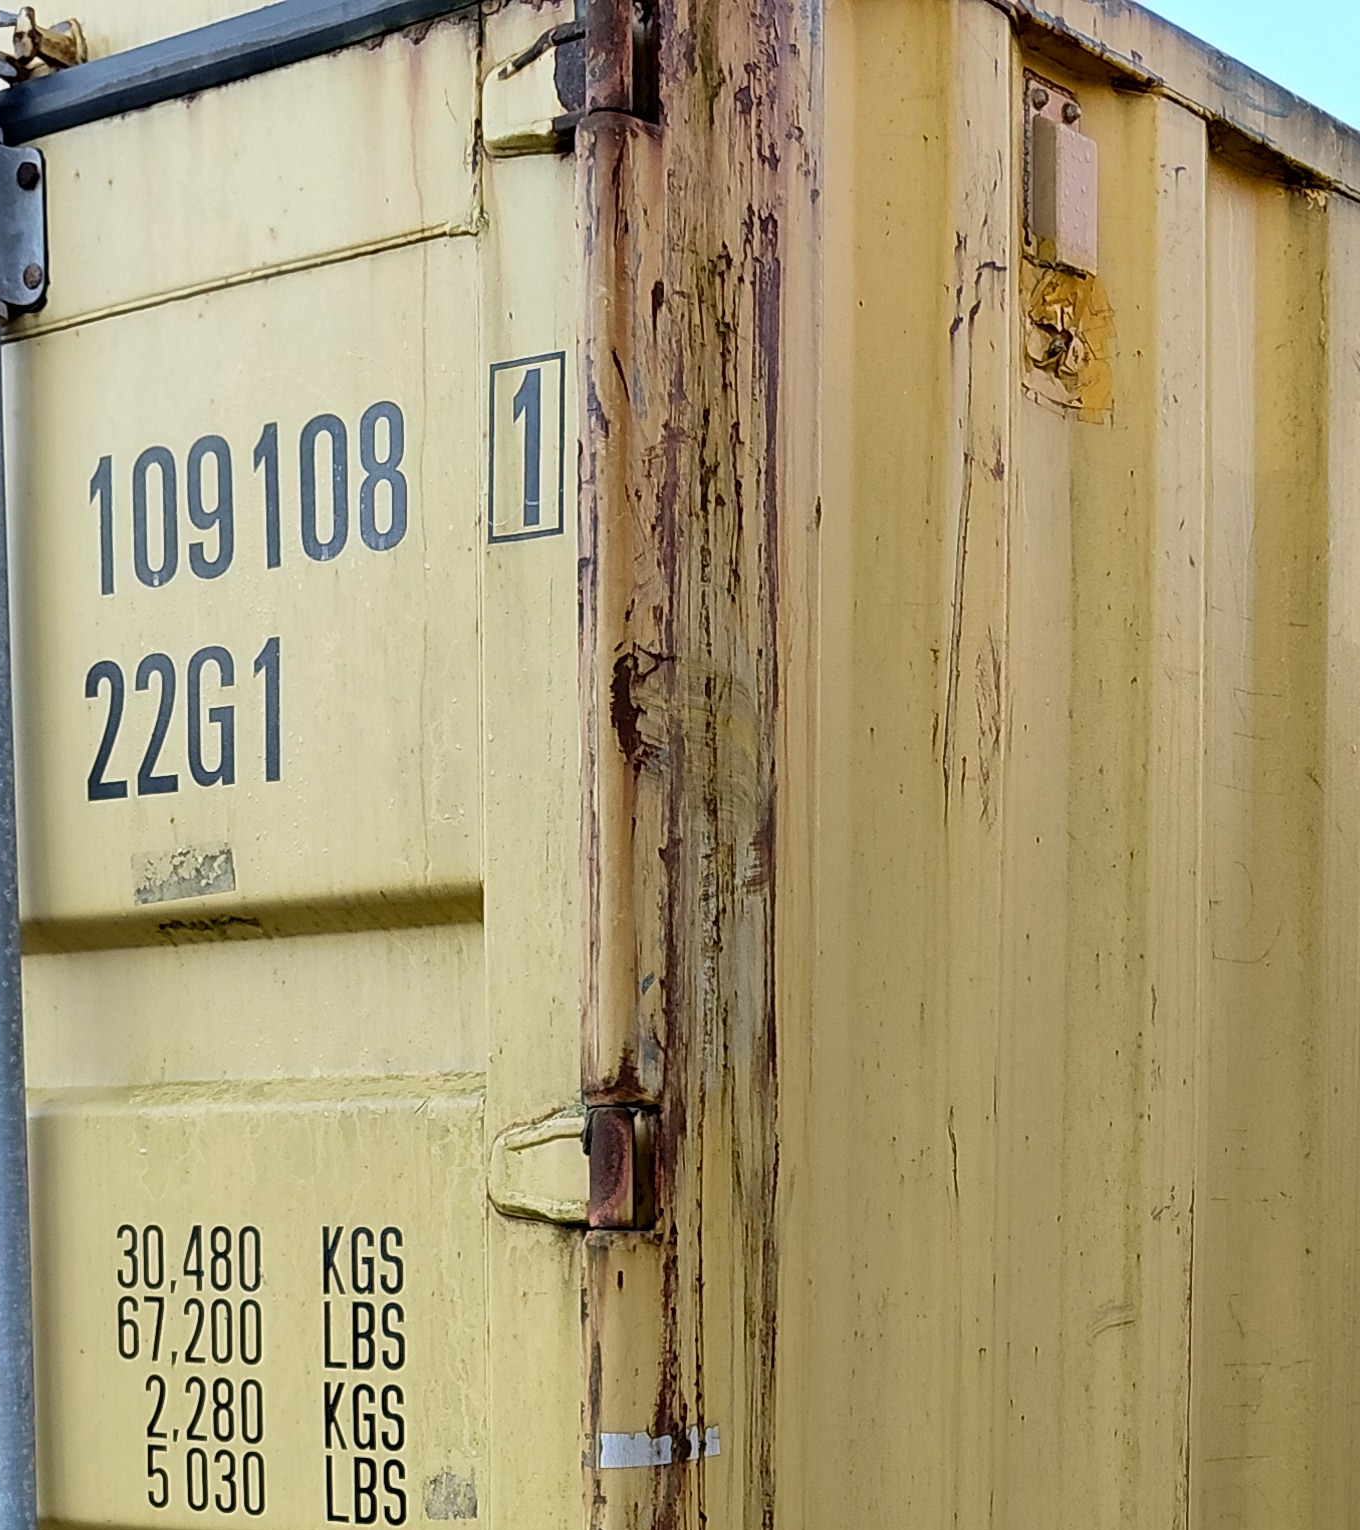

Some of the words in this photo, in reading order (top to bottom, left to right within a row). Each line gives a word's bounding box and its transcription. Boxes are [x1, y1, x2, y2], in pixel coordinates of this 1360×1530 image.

[88, 400, 408, 597] 109108
[511, 367, 542, 526] 1
[84, 636, 282, 802] 22G1
[116, 1223, 261, 1294] 30,480
[322, 1226, 404, 1295] KGS
[117, 1295, 263, 1366] 67,200
[323, 1301, 406, 1371] LBS
[145, 1374, 264, 1444] 2,280
[323, 1381, 405, 1452] KGS
[325, 1455, 407, 1526] LBS
